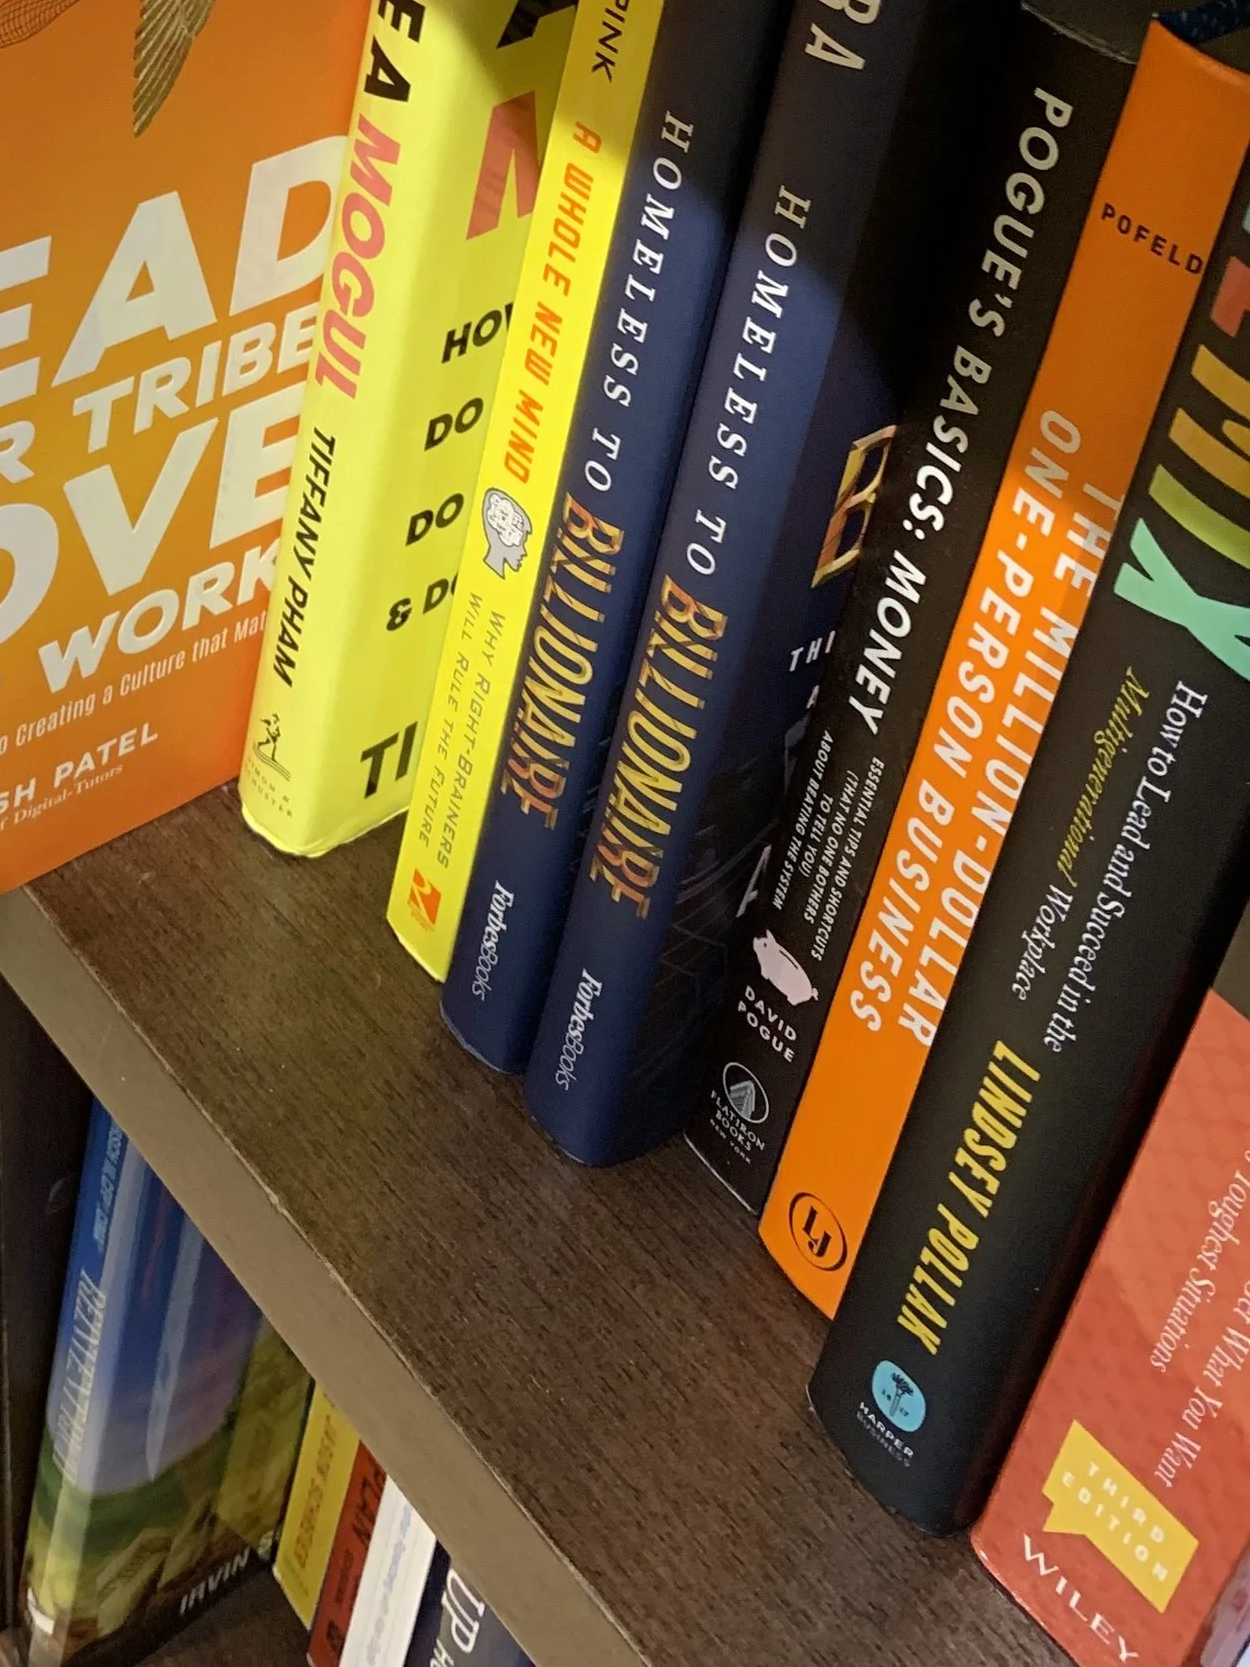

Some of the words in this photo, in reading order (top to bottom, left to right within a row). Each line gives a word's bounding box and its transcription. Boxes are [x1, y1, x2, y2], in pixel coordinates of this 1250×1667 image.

[363, 50, 411, 104] A
[573, 121, 604, 155] A
[542, 161, 596, 297] WHOLE
[968, 87, 1073, 336] POGUE'S
[1101, 203, 1204, 275] POFELD
[315, 114, 402, 401] MOGUL
[603, 110, 694, 408] HOMELESS
[441, 301, 514, 365] HO
[519, 303, 566, 387] NEW
[707, 185, 812, 491] HOMELESS
[72, 301, 320, 452] TRIBE
[422, 396, 484, 452] DO
[503, 387, 544, 485] MIND
[902, 346, 992, 542] BASICS:
[585, 426, 624, 493] TO
[292, 426, 336, 586] TIFFANY
[405, 492, 465, 548] DO
[1054, 481, 1126, 597] THE
[686, 508, 728, 576] TO
[38, 544, 281, 694] WORK
[459, 591, 482, 643] WILL
[933, 409, 1082, 779] ONE-PERSON
[272, 586, 311, 689] PHAM
[483, 609, 506, 666] WHY
[501, 492, 624, 830] BILLIONAIRE
[849, 548, 927, 734] MONEY
[15, 692, 97, 746] Creating
[102, 684, 114, 704] a
[119, 654, 185, 697] Culture
[191, 634, 229, 665] that
[444, 650, 470, 710] RULE
[1158, 680, 1209, 746] How
[54, 721, 159, 785] PATEL
[435, 668, 492, 870] RIGHT-BRAINERS
[437, 717, 456, 760] THE
[590, 574, 729, 920] BILLIONAIRE
[812, 730, 834, 779] ABOUT
[1148, 746, 1176, 778] to
[12, 763, 124, 824] Digital-Tutors
[419, 765, 446, 849] FUTURE
[795, 778, 819, 836] BEATING
[819, 792, 833, 814] TO
[838, 770, 859, 814] (THAT
[853, 757, 884, 826] ESSENTIAL
[1056, 666, 1150, 887] Multigenerational
[810, 814, 826, 843] TELL
[831, 810, 847, 835] NO
[844, 827, 862, 857] TIPS
[897, 605, 1079, 1047] MILLION-DOLLAR
[1122, 776, 1171, 849] Lead
[787, 835, 802, 863] THE
[798, 845, 818, 878] YOU)
[821, 835, 839, 868] ONE
[834, 855, 852, 887] AND
[1103, 844, 1135, 898] and
[772, 861, 794, 910] SYSTEM
[803, 866, 829, 924] BOTHERS
[850, 778, 955, 1033] BUSINESS
[811, 887, 843, 961] SHORTCUTS
[1012, 884, 1073, 1001] Workplace
[1073, 890, 1127, 994] Succeed
[738, 1000, 795, 1062] POGUE
[745, 985, 796, 1041] DAVID
[1044, 1009, 1078, 1053] the
[1057, 982, 1091, 1015] in
[711, 1090, 765, 1150] FLATIRON
[716, 1110, 751, 1151] BOOKS
[949, 1039, 1042, 1217] LINDSEY
[897, 1202, 979, 1356] POLLAK
[1150, 1266, 1216, 1373] Situations
[1203, 1324, 1250, 1388] What
[859, 1401, 914, 1458] HARPER
[1182, 1385, 1223, 1431] You
[1154, 1431, 1202, 1488] Want
[1062, 1471, 1169, 1583] EDITION
[1088, 1460, 1165, 1544] THIRD
[1022, 1533, 1139, 1663] WILEY
